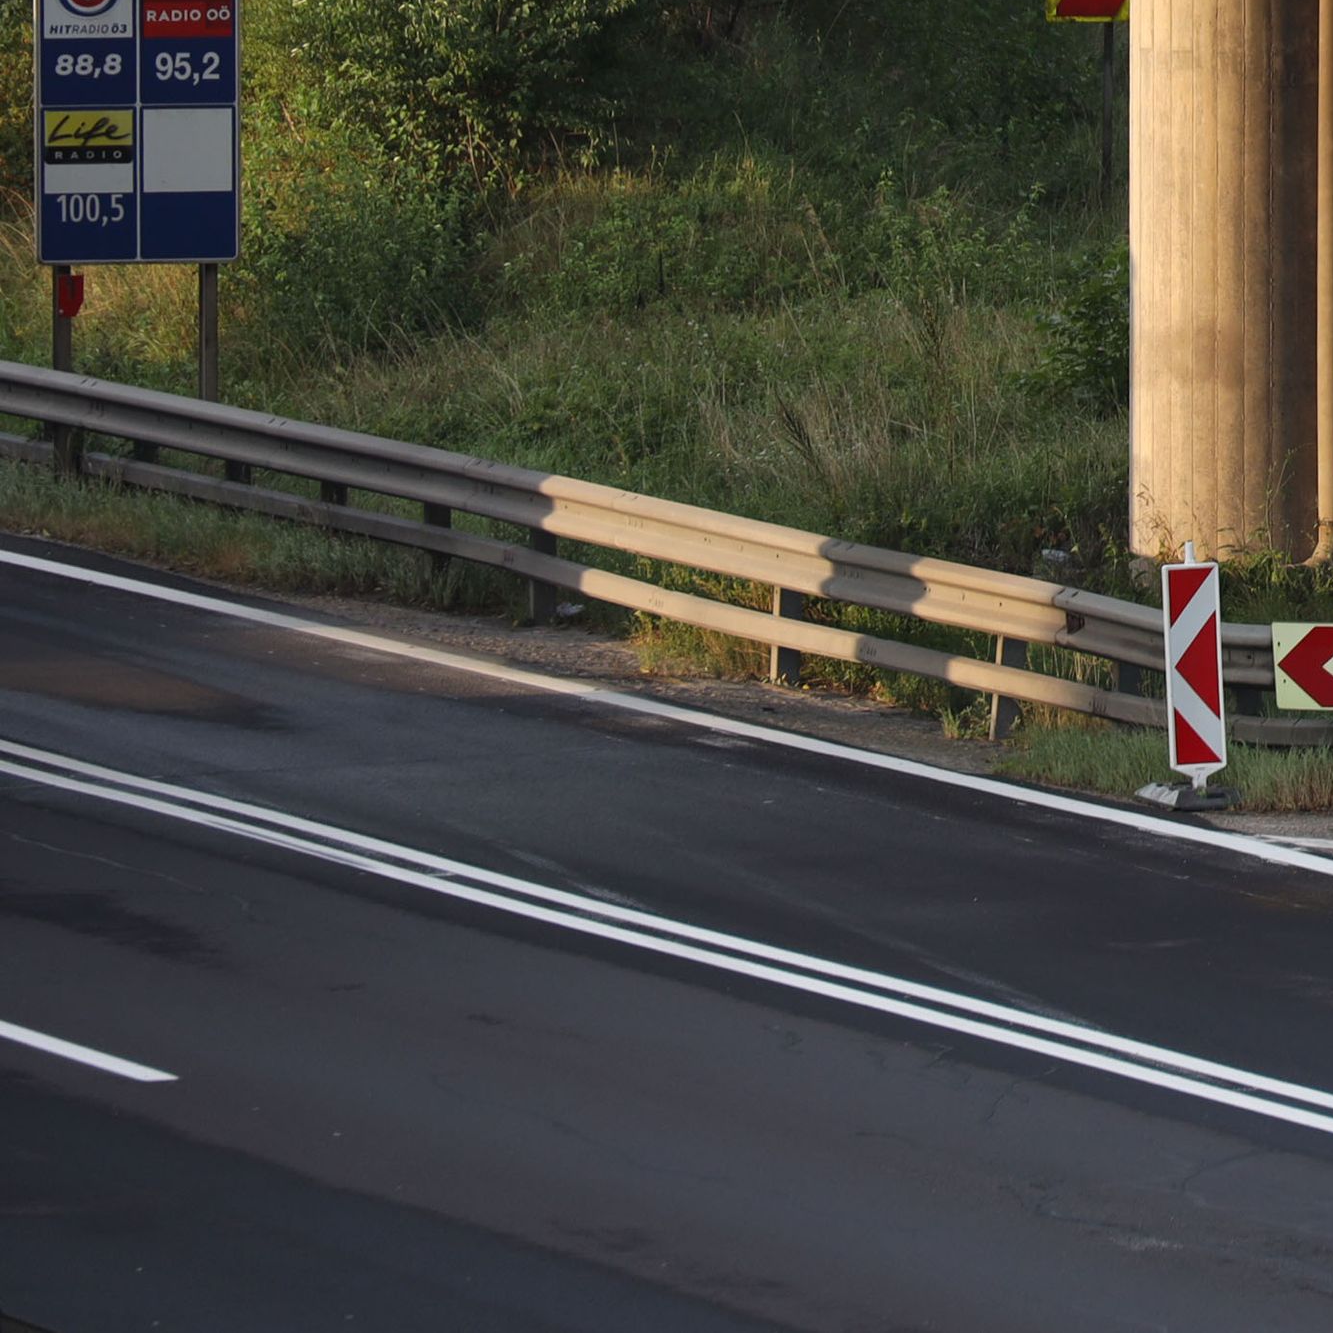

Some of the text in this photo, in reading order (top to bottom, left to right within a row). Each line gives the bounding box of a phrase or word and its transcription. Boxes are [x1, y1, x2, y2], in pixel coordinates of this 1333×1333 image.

[147, 5, 231, 22] RADIO OÖ
[49, 24, 109, 35] HITRADIO
[55, 53, 122, 79] 88,8
[155, 51, 220, 86] 95,2
[48, 115, 131, 146] Life
[55, 150, 122, 160] RADIO
[56, 193, 125, 227] 100,5
